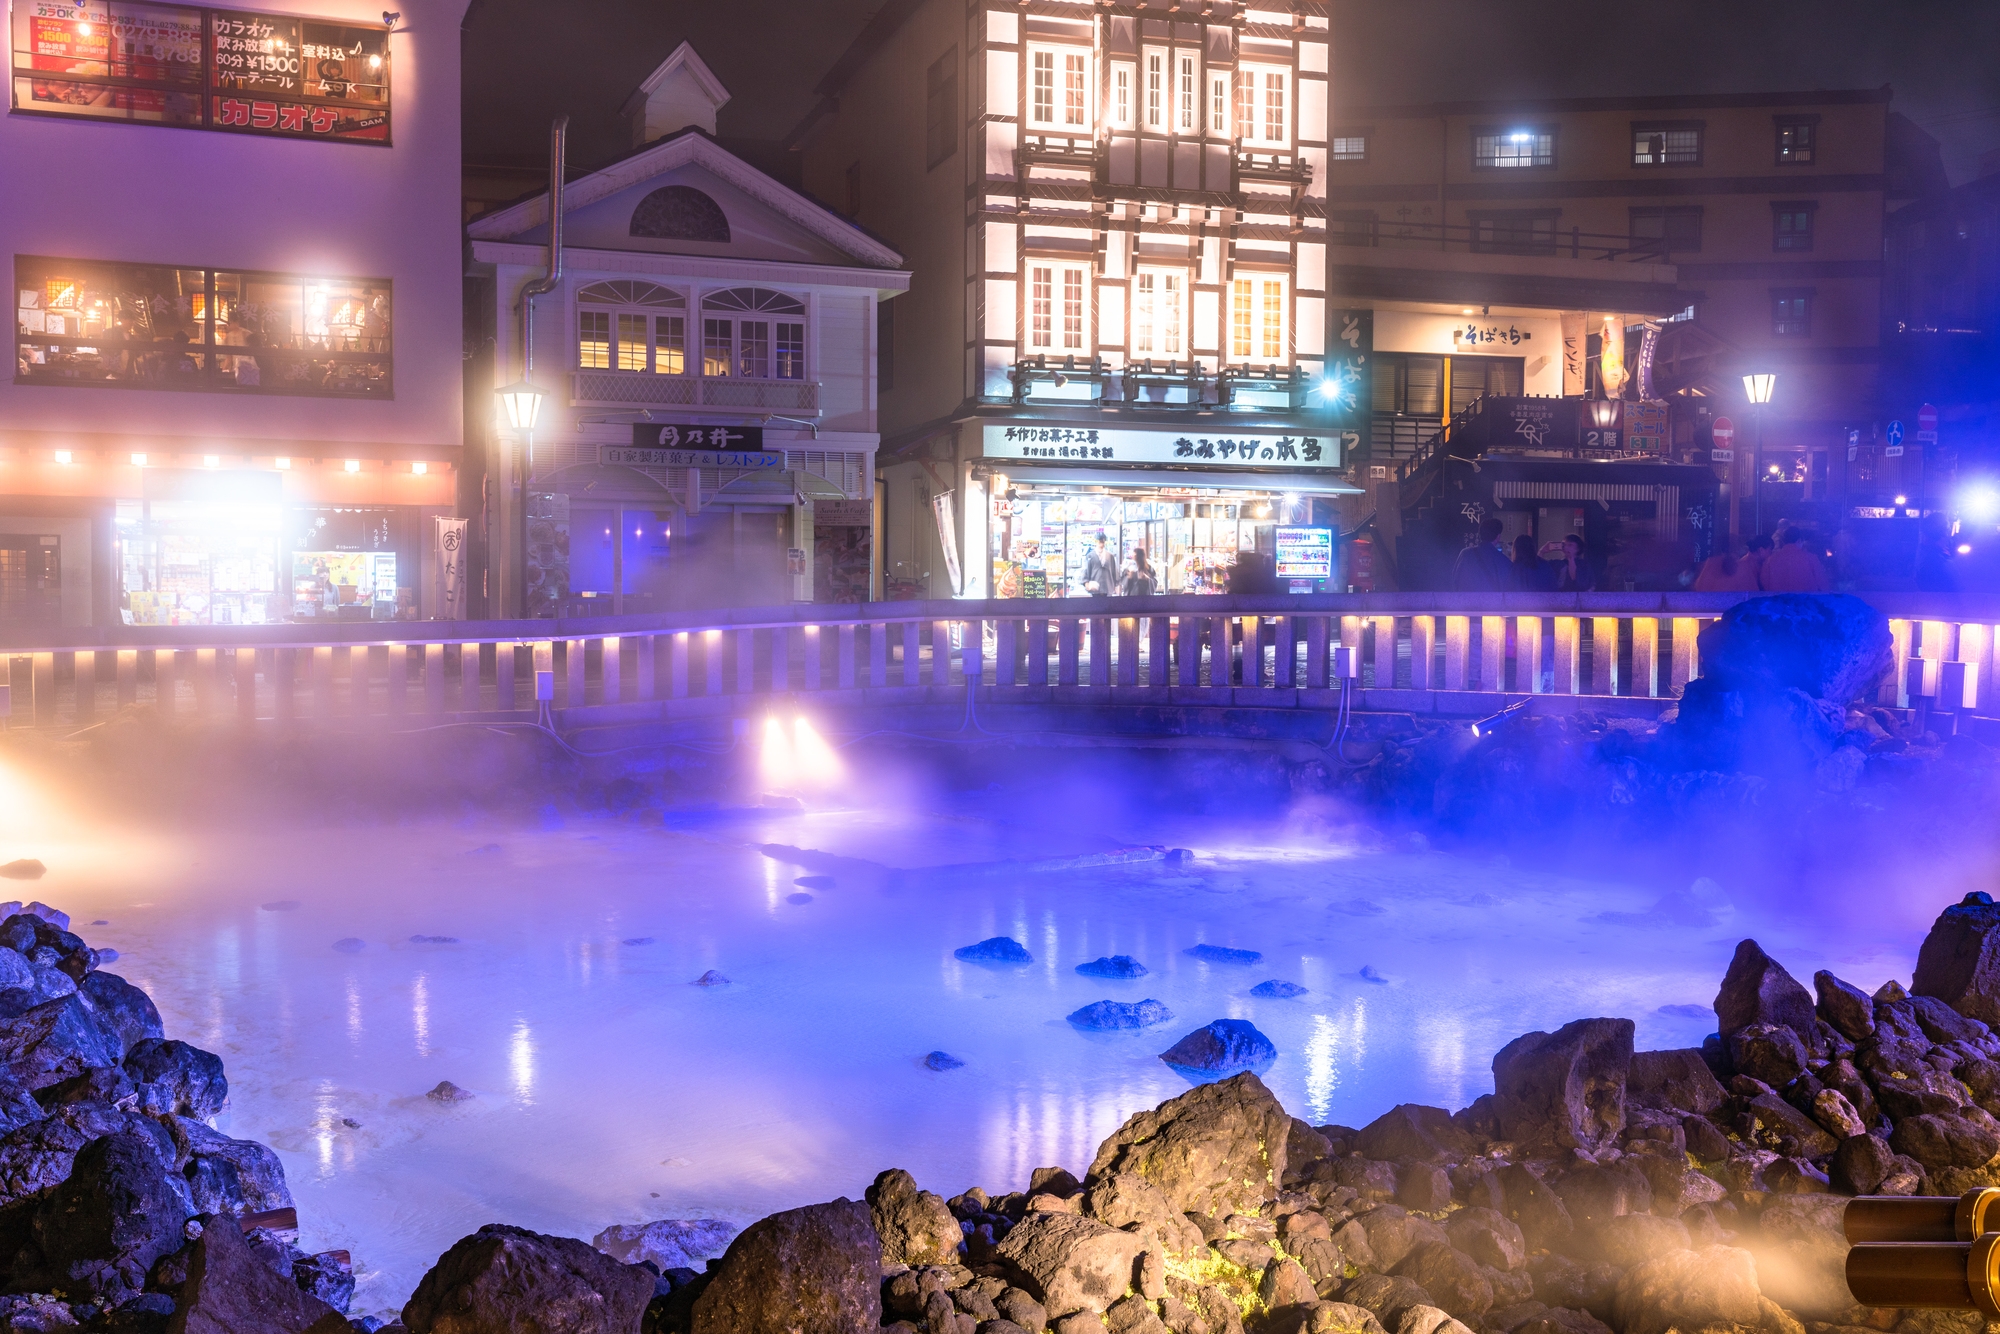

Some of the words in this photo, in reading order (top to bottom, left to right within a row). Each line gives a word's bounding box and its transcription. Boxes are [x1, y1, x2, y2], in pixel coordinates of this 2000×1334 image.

[38, 7, 74, 19] カラOK
[38, 30, 71, 43] ¥1500
[216, 19, 274, 38] カラオケ
[217, 35, 274, 54] 飲み放題
[302, 44, 346, 61] 室料込
[216, 53, 244, 68] 60分
[247, 55, 299, 74] ¥1500
[222, 98, 339, 133] カラオケ
[360, 117, 383, 127] DAM
[1465, 324, 1521, 346] そばきち
[1564, 337, 1578, 375] ランチ
[1625, 404, 1666, 419] スマート
[659, 426, 744, 448] 月乃井
[1005, 427, 1100, 444] 手作りお菓子工房
[1633, 421, 1665, 435] ボール
[1587, 431, 1617, 447] 2階
[1633, 437, 1657, 449] 3階
[609, 449, 698, 464] 自家製洋菓子
[702, 455, 711, 464] &
[716, 453, 778, 467] レストラン
[1173, 436, 1322, 462] おみやげの本多
[445, 561, 456, 620] たこ
